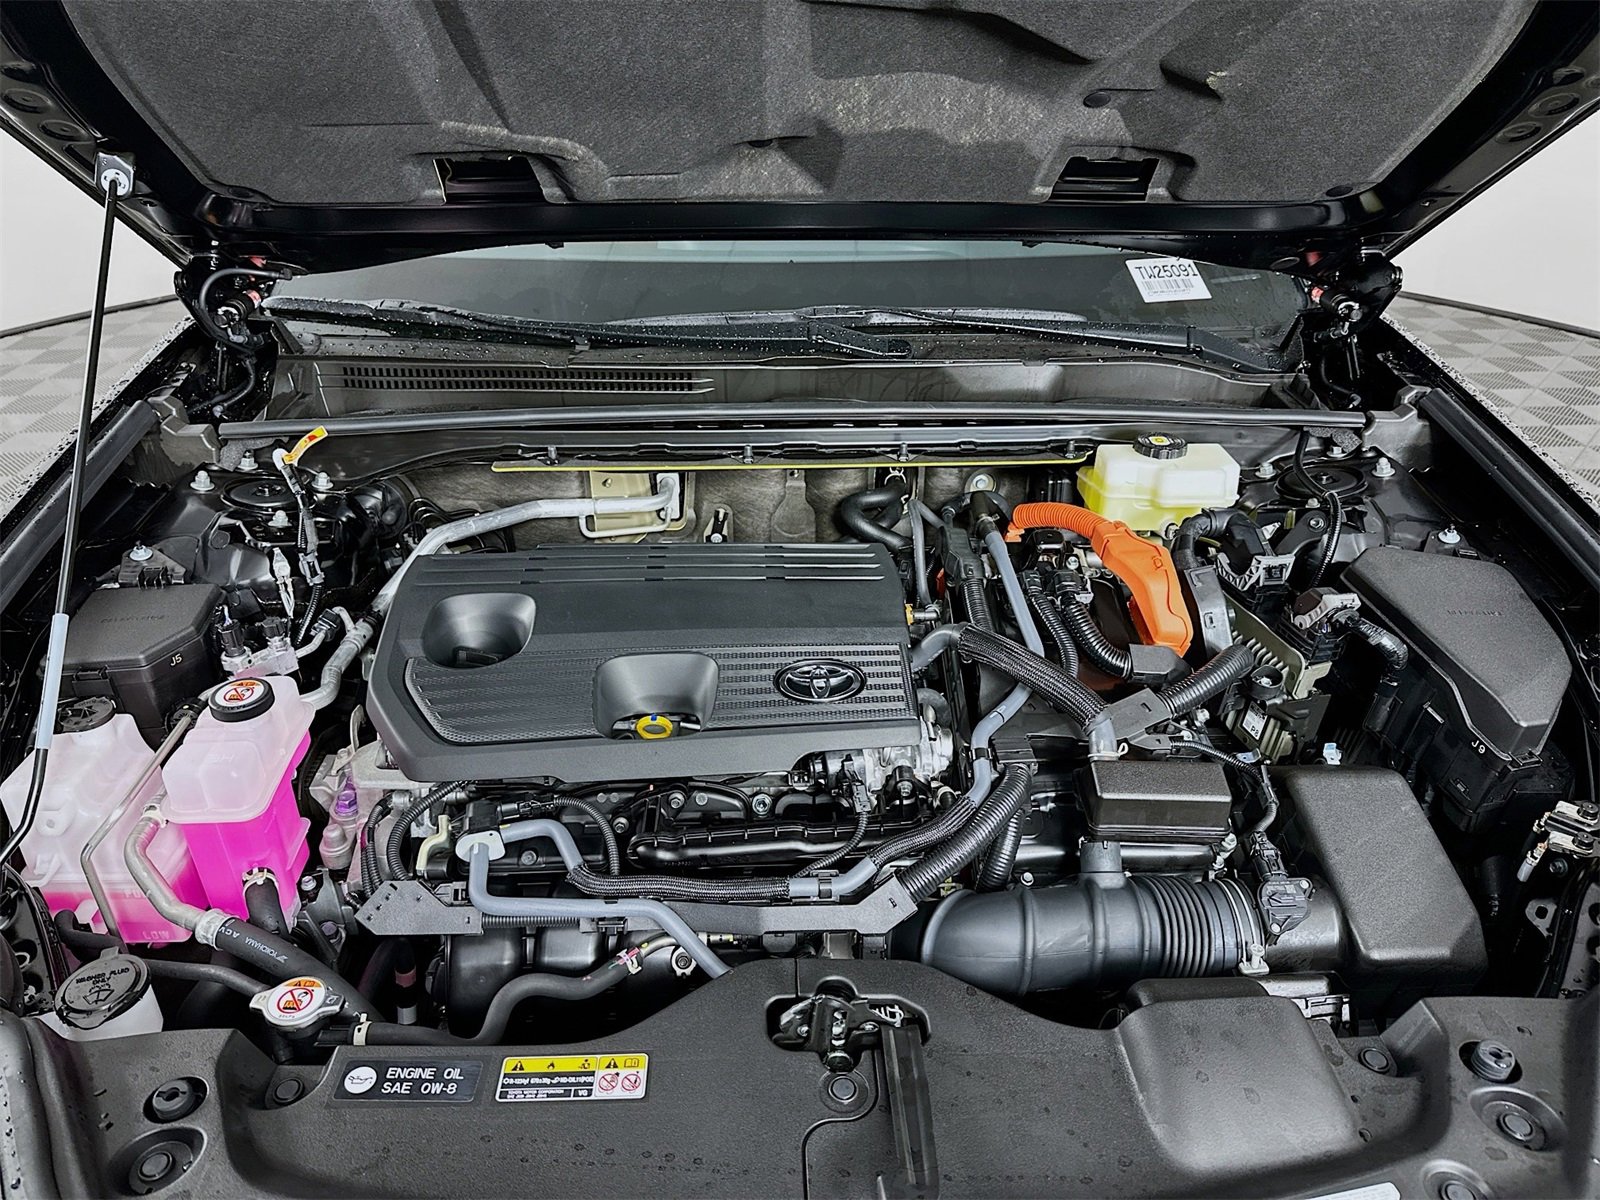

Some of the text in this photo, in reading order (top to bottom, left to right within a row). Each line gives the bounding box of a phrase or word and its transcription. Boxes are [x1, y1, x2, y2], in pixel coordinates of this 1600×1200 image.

[1134, 263, 1199, 280] TW25091
[169, 653, 183, 667] J5
[1471, 740, 1486, 754] J9
[142, 930, 170, 940] LOW
[244, 936, 278, 959] YOKOHAMA
[385, 1067, 465, 1080] ENGINE OIL
[381, 1081, 413, 1094] SAE
